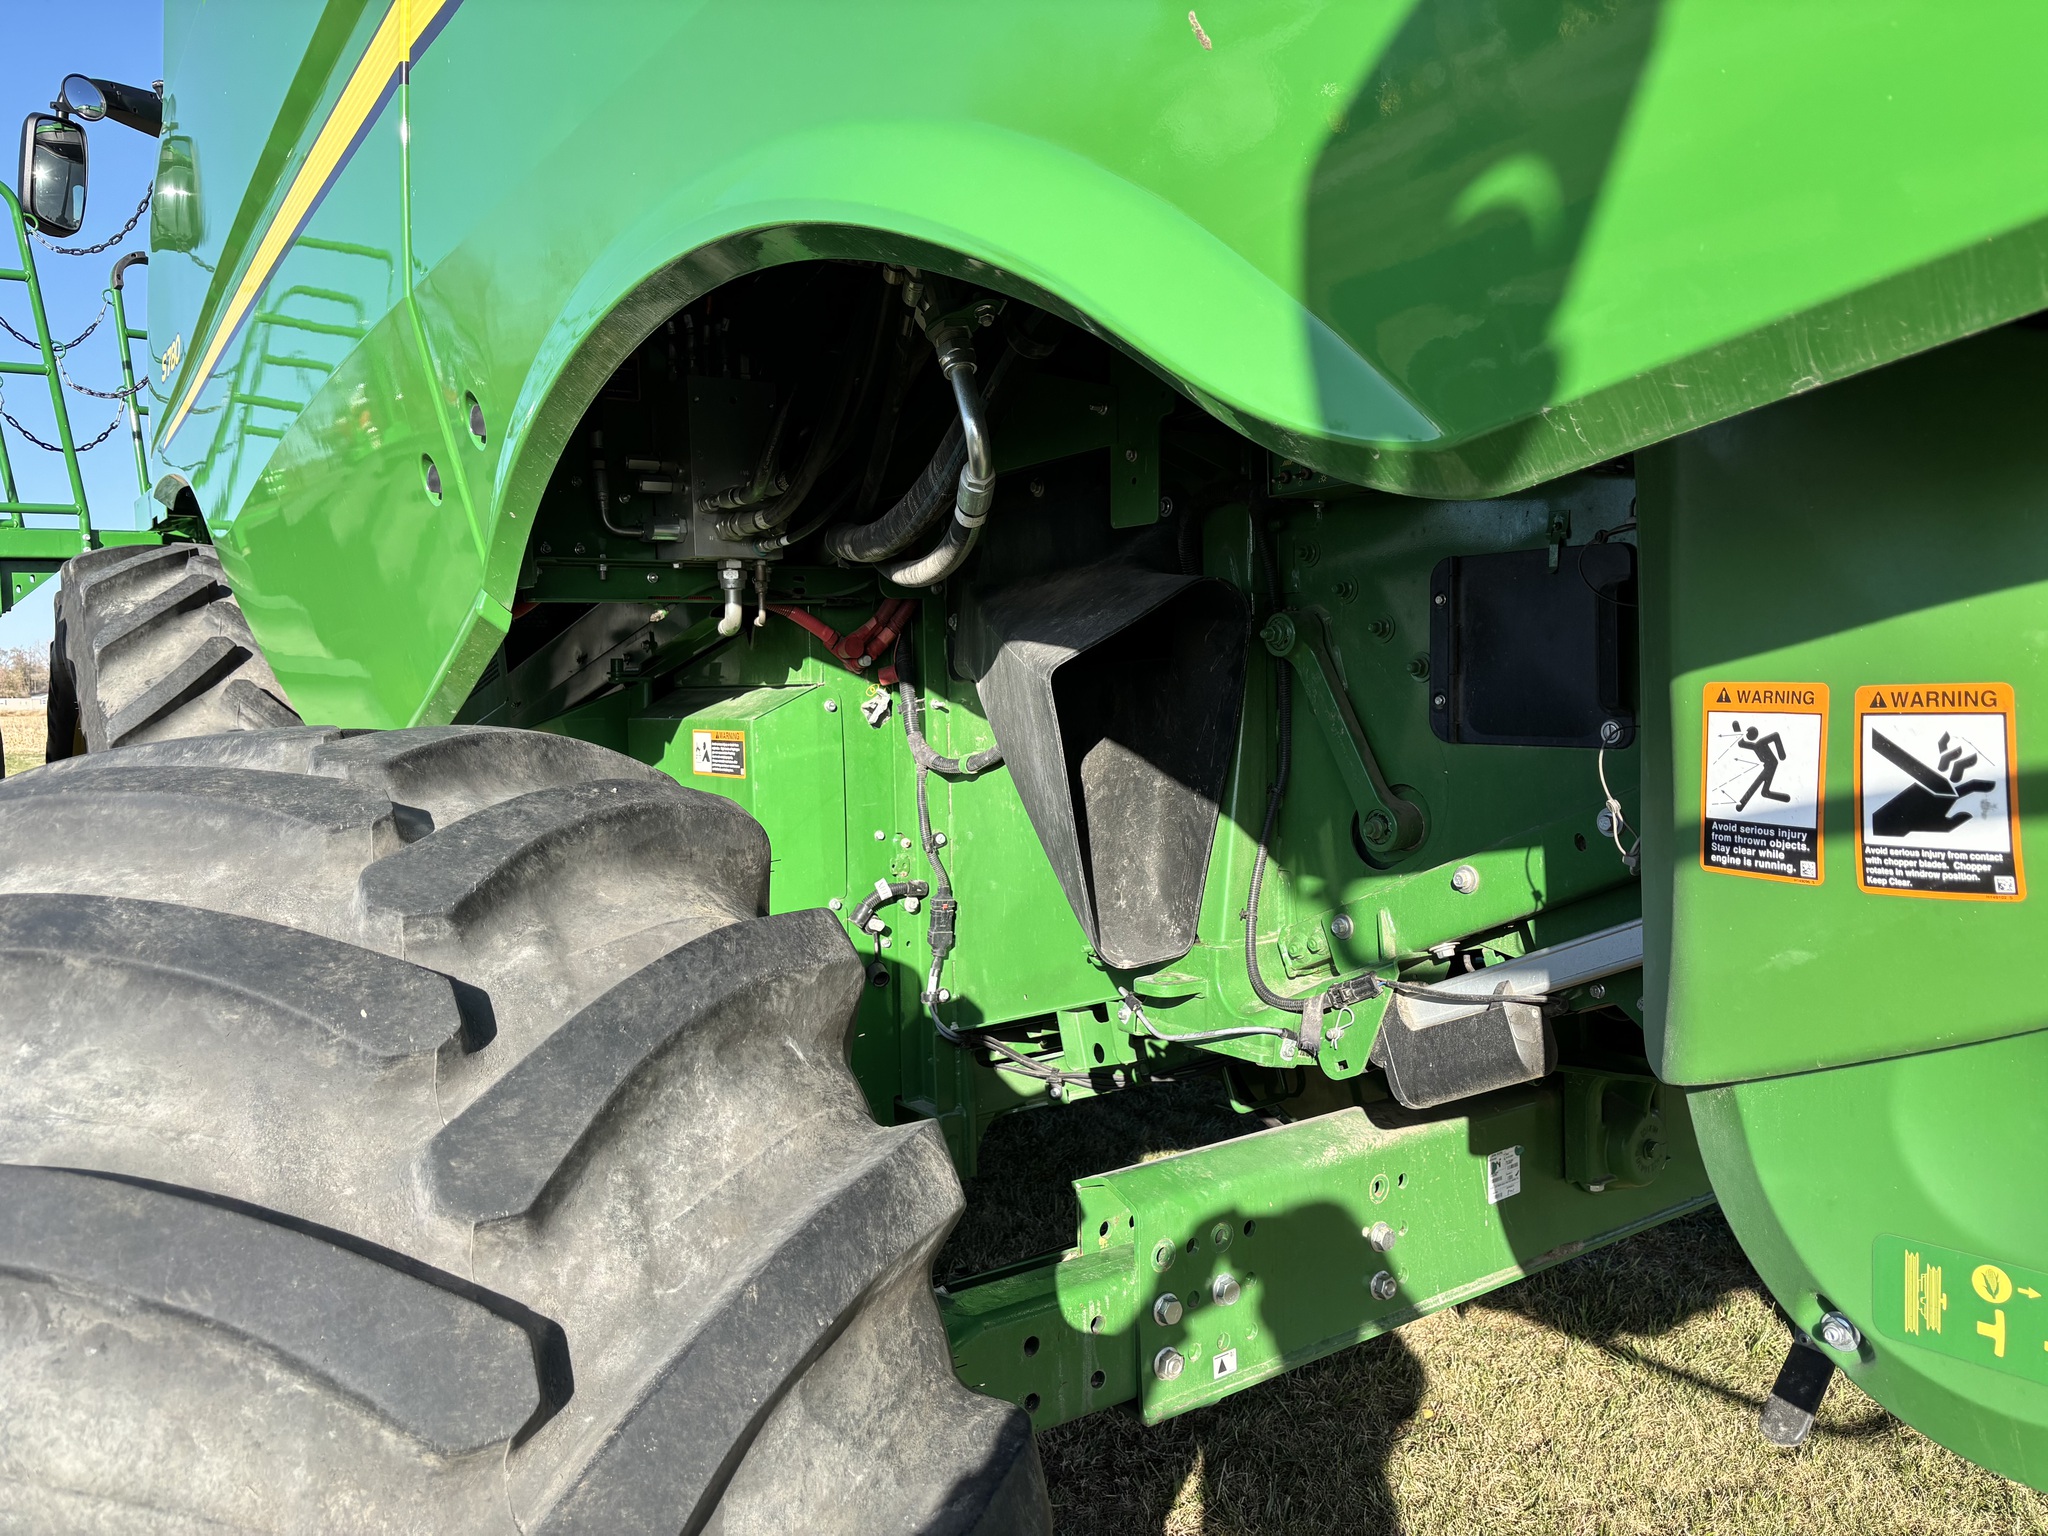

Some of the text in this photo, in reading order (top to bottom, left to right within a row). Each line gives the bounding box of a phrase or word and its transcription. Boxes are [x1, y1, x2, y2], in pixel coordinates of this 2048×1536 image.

[161, 333, 181, 383] S780
[1737, 690, 1815, 705] WARNING
[1891, 690, 1997, 708] WARNING
[1711, 821, 1808, 842] Avoid serious injury
[1711, 832, 1811, 852] from thrown objects.
[1711, 842, 1785, 860] Stay clear while
[1865, 846, 2004, 862] Avoid serious injury from contact
[1711, 854, 1797, 874] engine is running.
[1865, 856, 1992, 873] with chopper blades. Chopper
[1866, 866, 1981, 883] rotates in windrow position.
[1866, 876, 1913, 888] Keep Clear.
